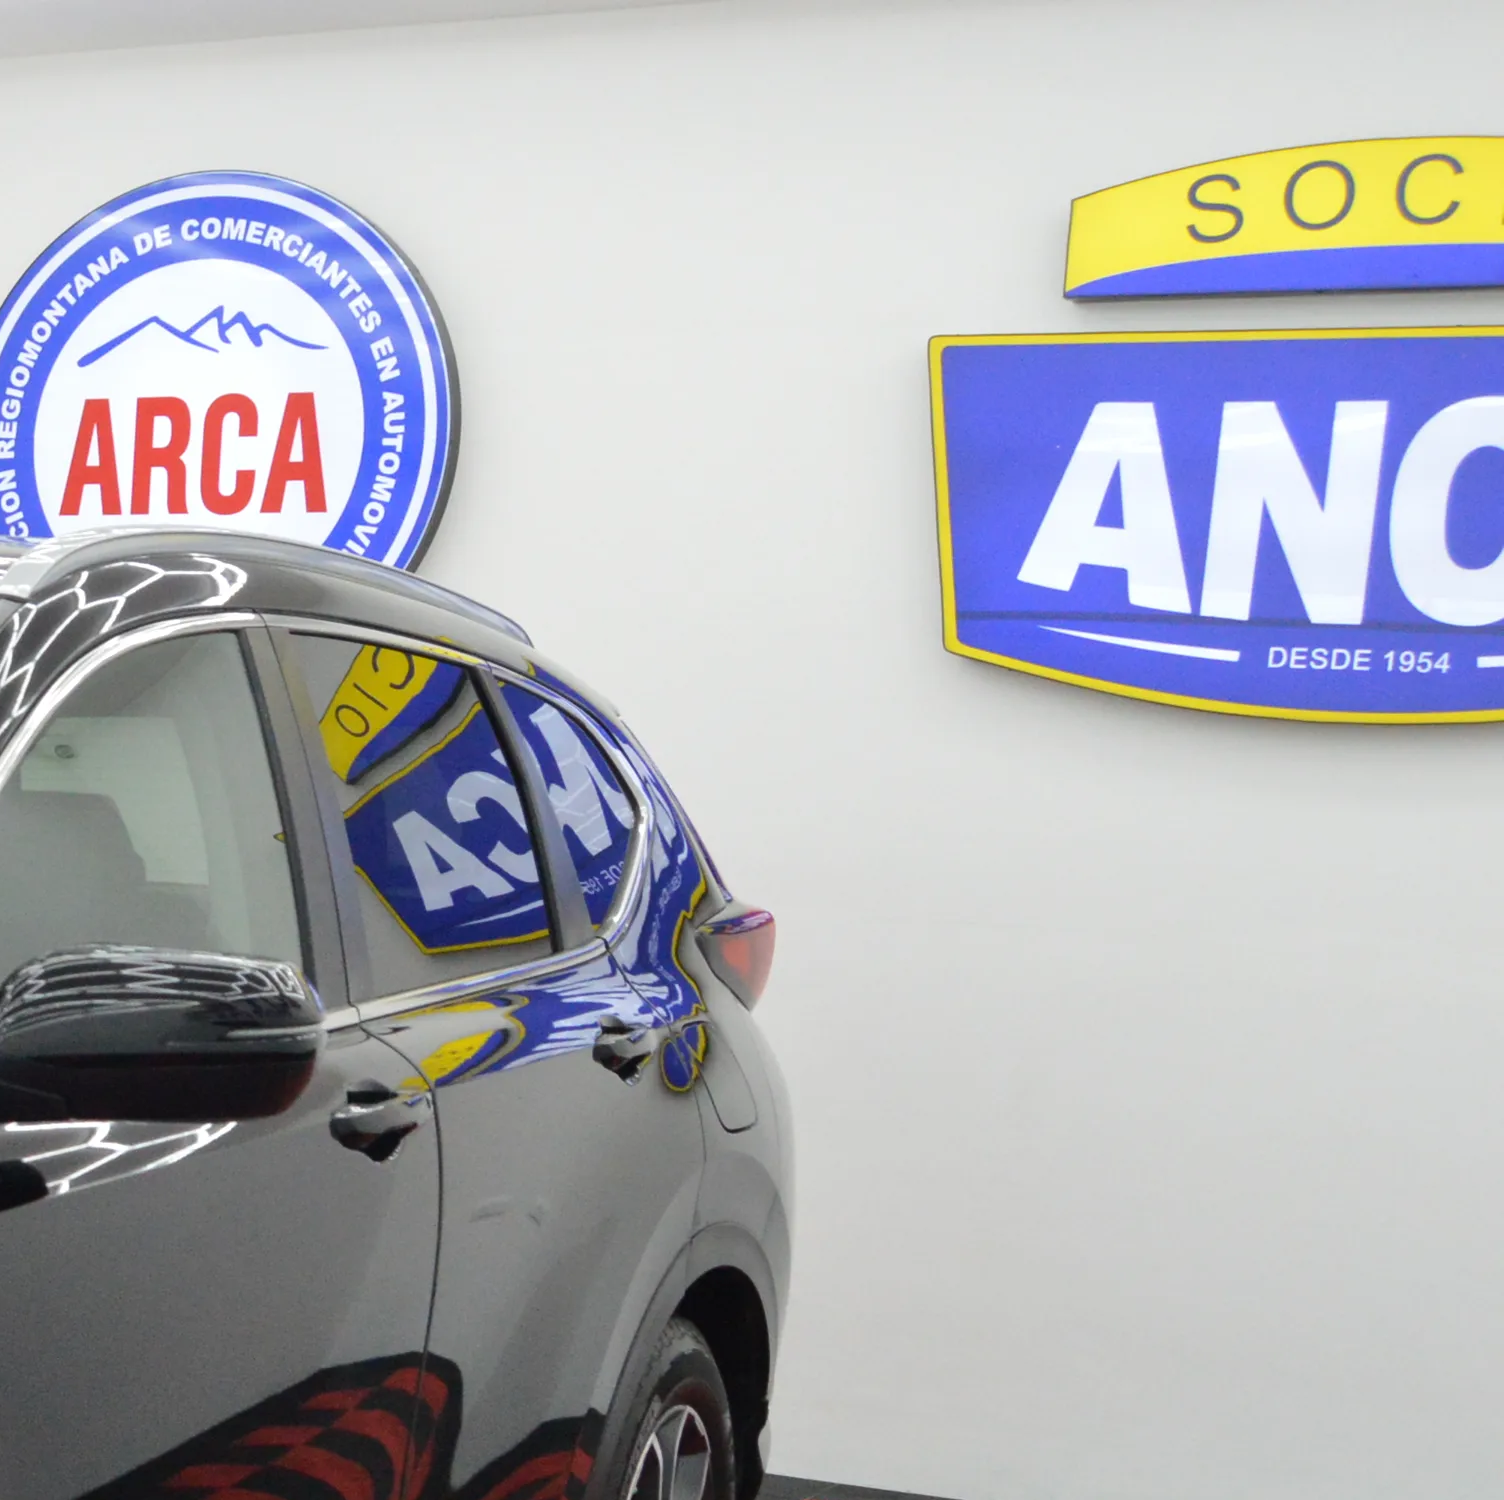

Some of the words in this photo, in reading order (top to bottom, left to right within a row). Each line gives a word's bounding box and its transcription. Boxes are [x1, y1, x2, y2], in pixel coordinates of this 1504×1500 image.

[133, 223, 173, 257] DE
[1186, 153, 1504, 243] SOC
[180, 216, 381, 334] COMERCIANTES
[370, 336, 401, 382] EN
[58, 392, 328, 517] ARCA
[342, 391, 406, 556] AUTOMOVI
[1267, 646, 1372, 672] DESDE
[1383, 650, 1452, 674] 1954
